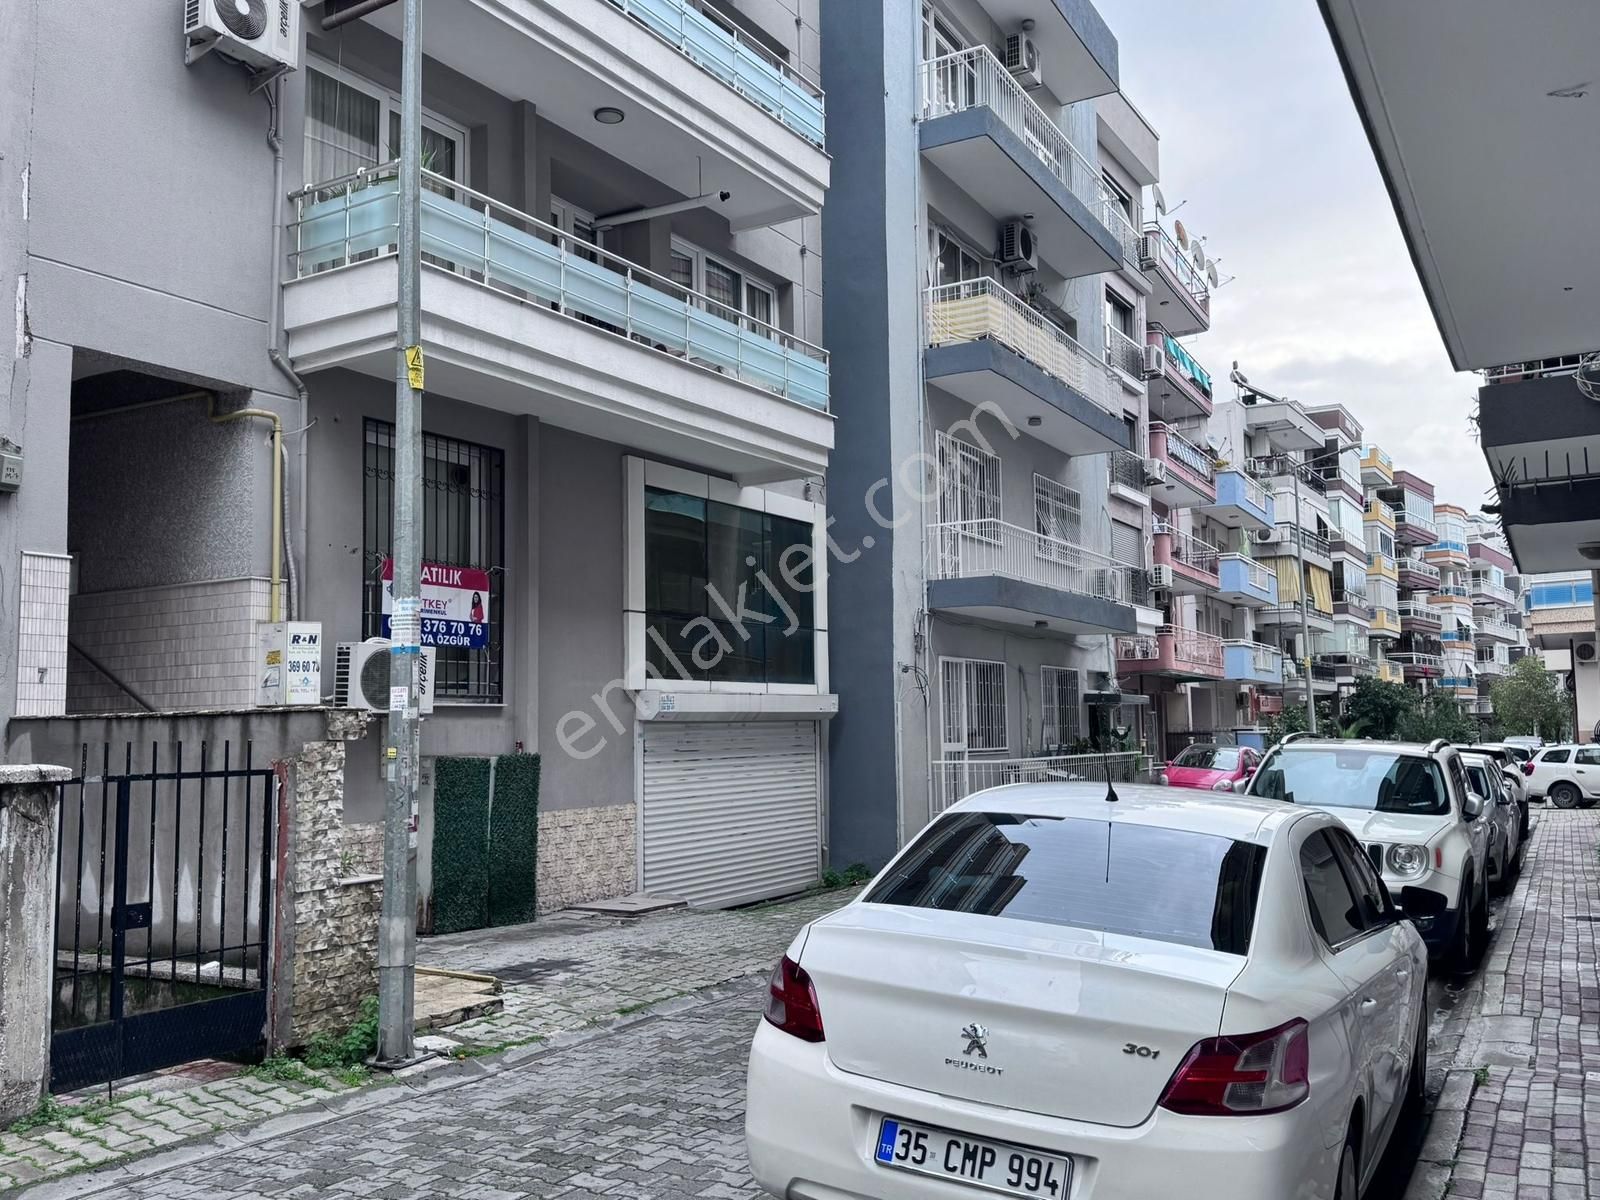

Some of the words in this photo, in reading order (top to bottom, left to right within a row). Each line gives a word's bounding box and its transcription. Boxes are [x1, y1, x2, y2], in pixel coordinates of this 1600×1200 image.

[421, 566, 462, 585] ATILIK
[422, 599, 447, 609] TKEY
[424, 620, 446, 633] 376
[450, 622, 464, 634] 70
[469, 623, 482, 636] 76
[421, 634, 435, 644] YA
[437, 633, 470, 646] ÖZGÜR
[288, 660, 300, 672] 369
[302, 660, 310, 672] 60
[420, 652, 428, 695] arçelik
[1122, 1043, 1160, 1059] 301
[944, 1058, 1004, 1076] PEUGEOT
[881, 1143, 892, 1154] TR
[895, 1128, 928, 1164] 35
[944, 1140, 996, 1180] CMP
[1006, 1154, 1058, 1196] 994
